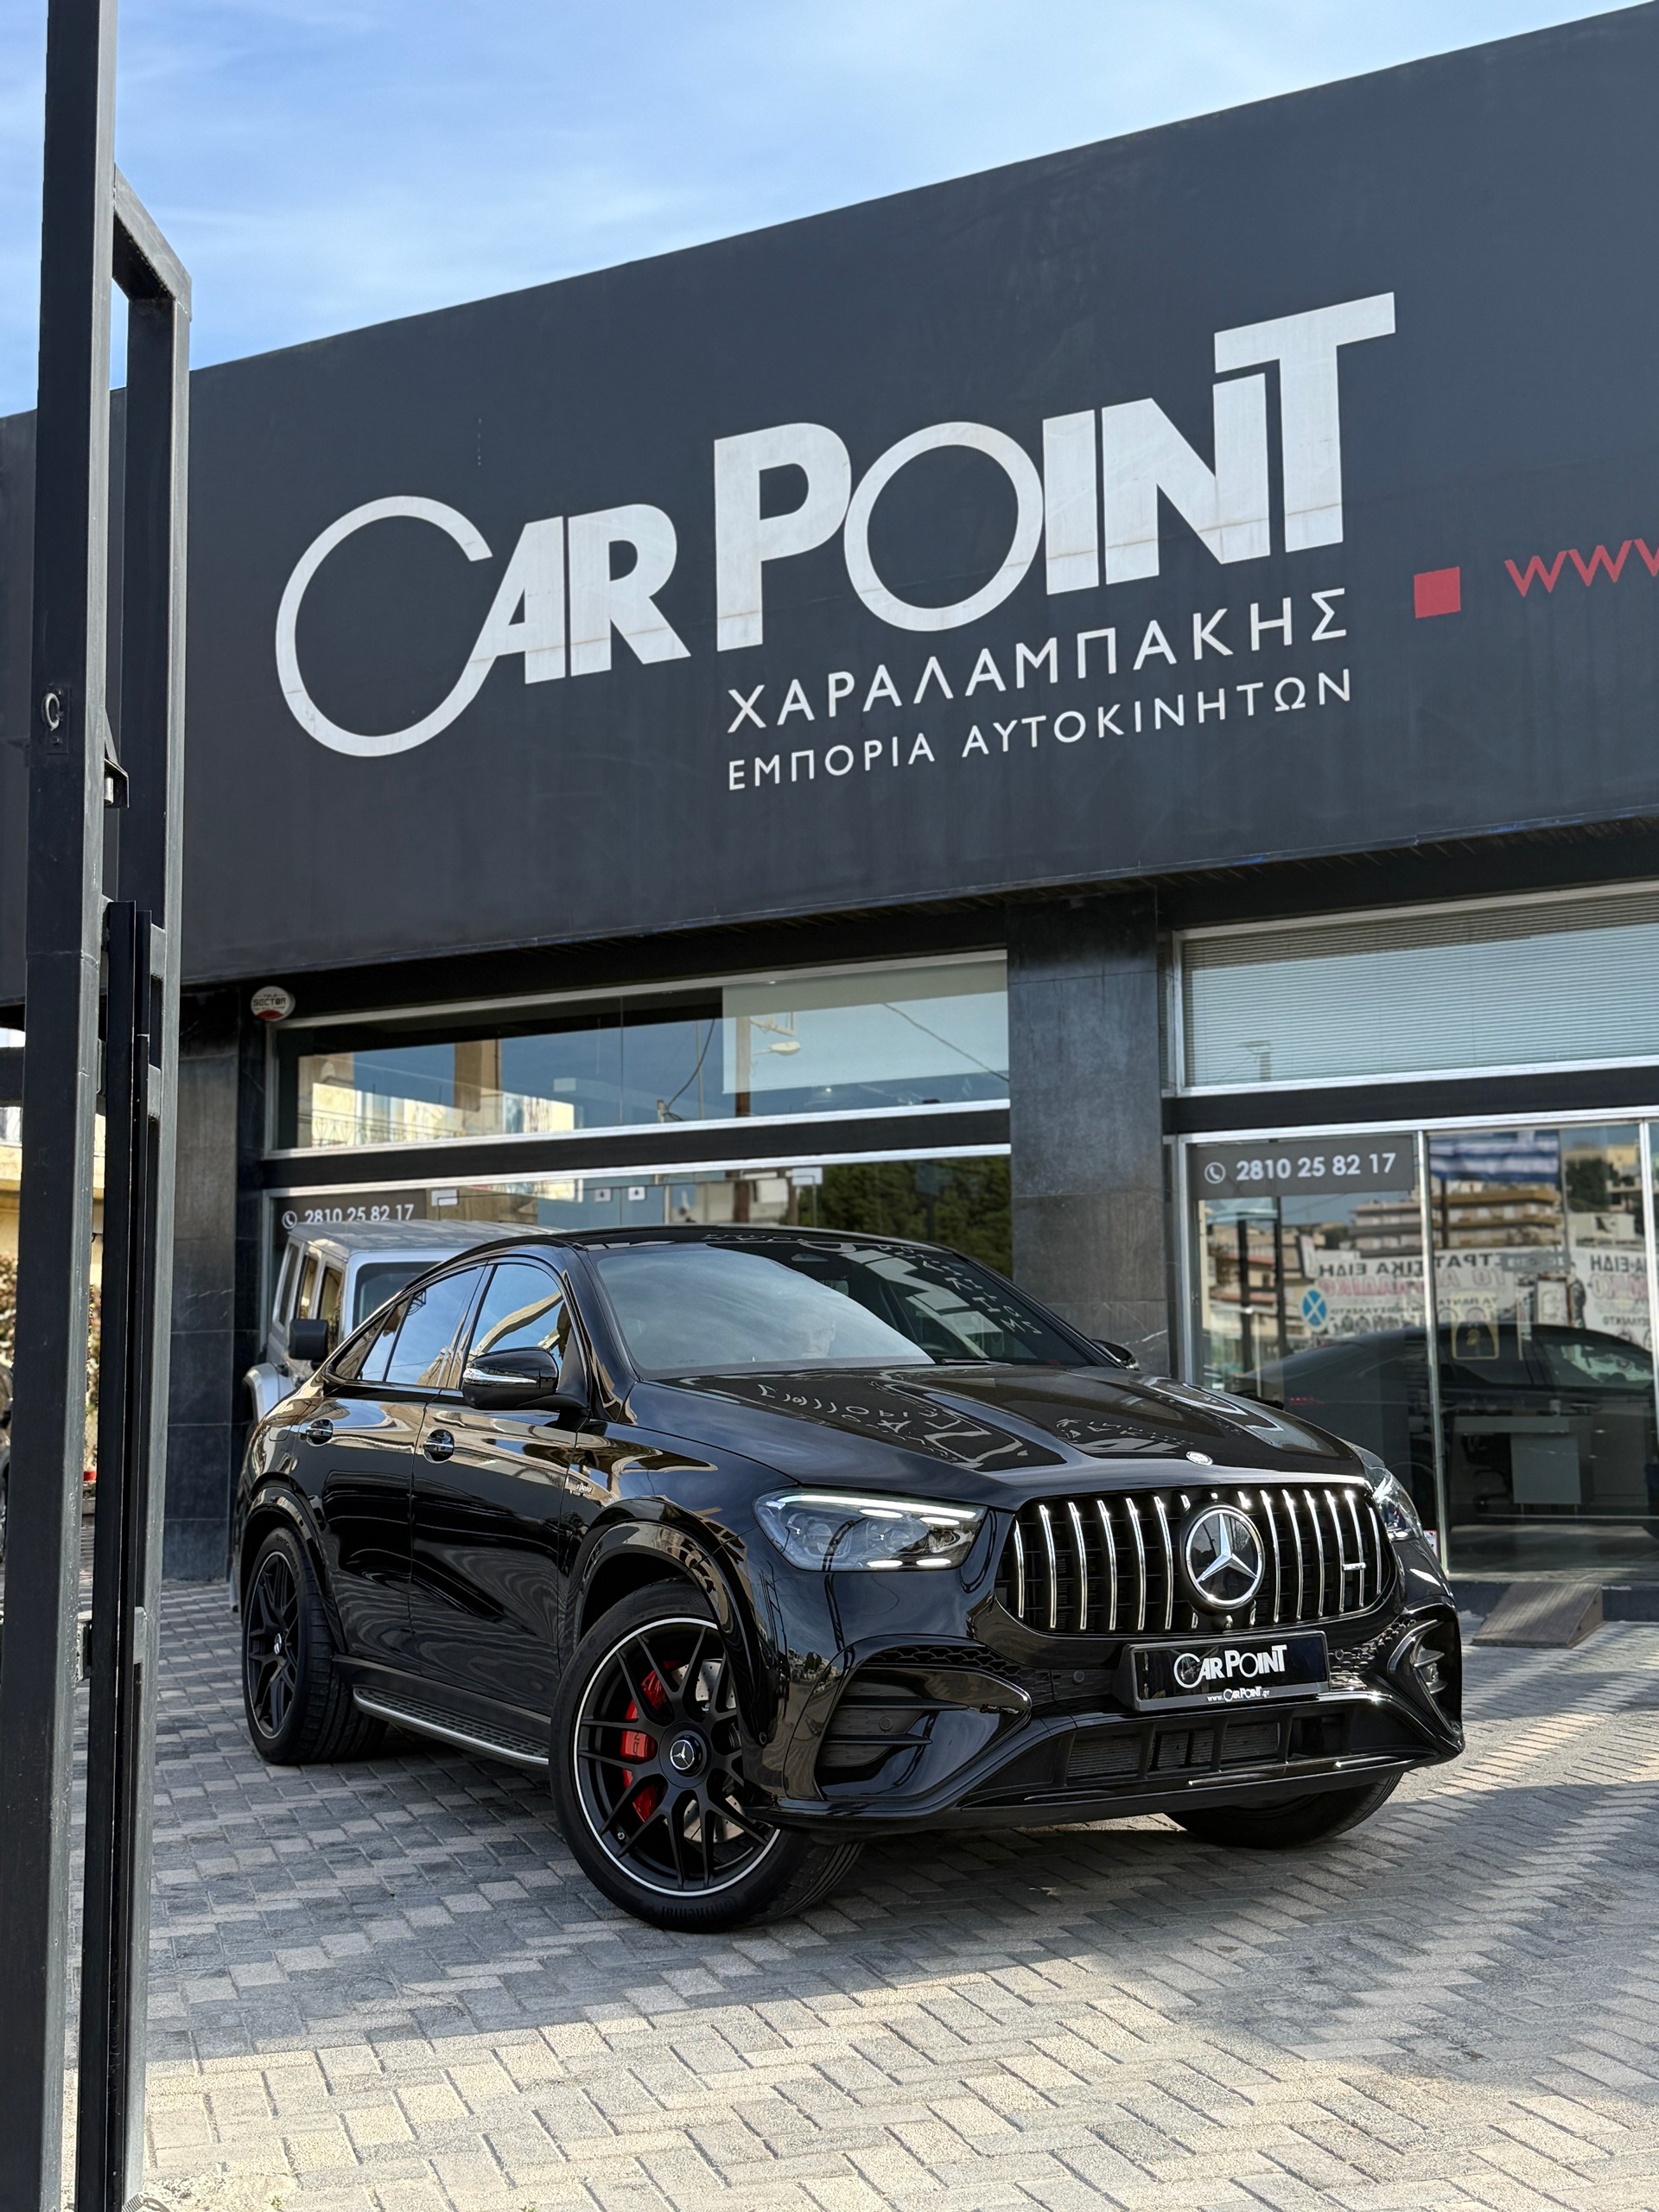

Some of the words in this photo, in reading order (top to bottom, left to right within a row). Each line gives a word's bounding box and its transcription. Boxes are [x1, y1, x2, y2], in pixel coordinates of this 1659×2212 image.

[276, 495, 691, 757] CAR
[714, 291, 1395, 652] POINT
[727, 588, 1348, 734] ΧΑΡΑΛΑΜΠΑΚΗΣ
[728, 732, 936, 791] ΕΜΠΟΡΙΑ
[962, 669, 1352, 759] ΑΥΤΟΚΙΝΗΤΩΝ
[252, 997, 287, 1007] SECTOR
[1236, 1158, 1292, 1181] 2810
[1298, 1156, 1325, 1178] 25
[1332, 1154, 1361, 1176] 82
[1370, 1153, 1396, 1173] 17
[304, 1208, 343, 1224] 2810
[346, 1207, 366, 1222] 25
[370, 1205, 391, 1221] 82
[395, 1204, 415, 1221] 17
[1173, 1652, 1225, 1688] CAR
[1224, 1644, 1287, 1678] POINT
